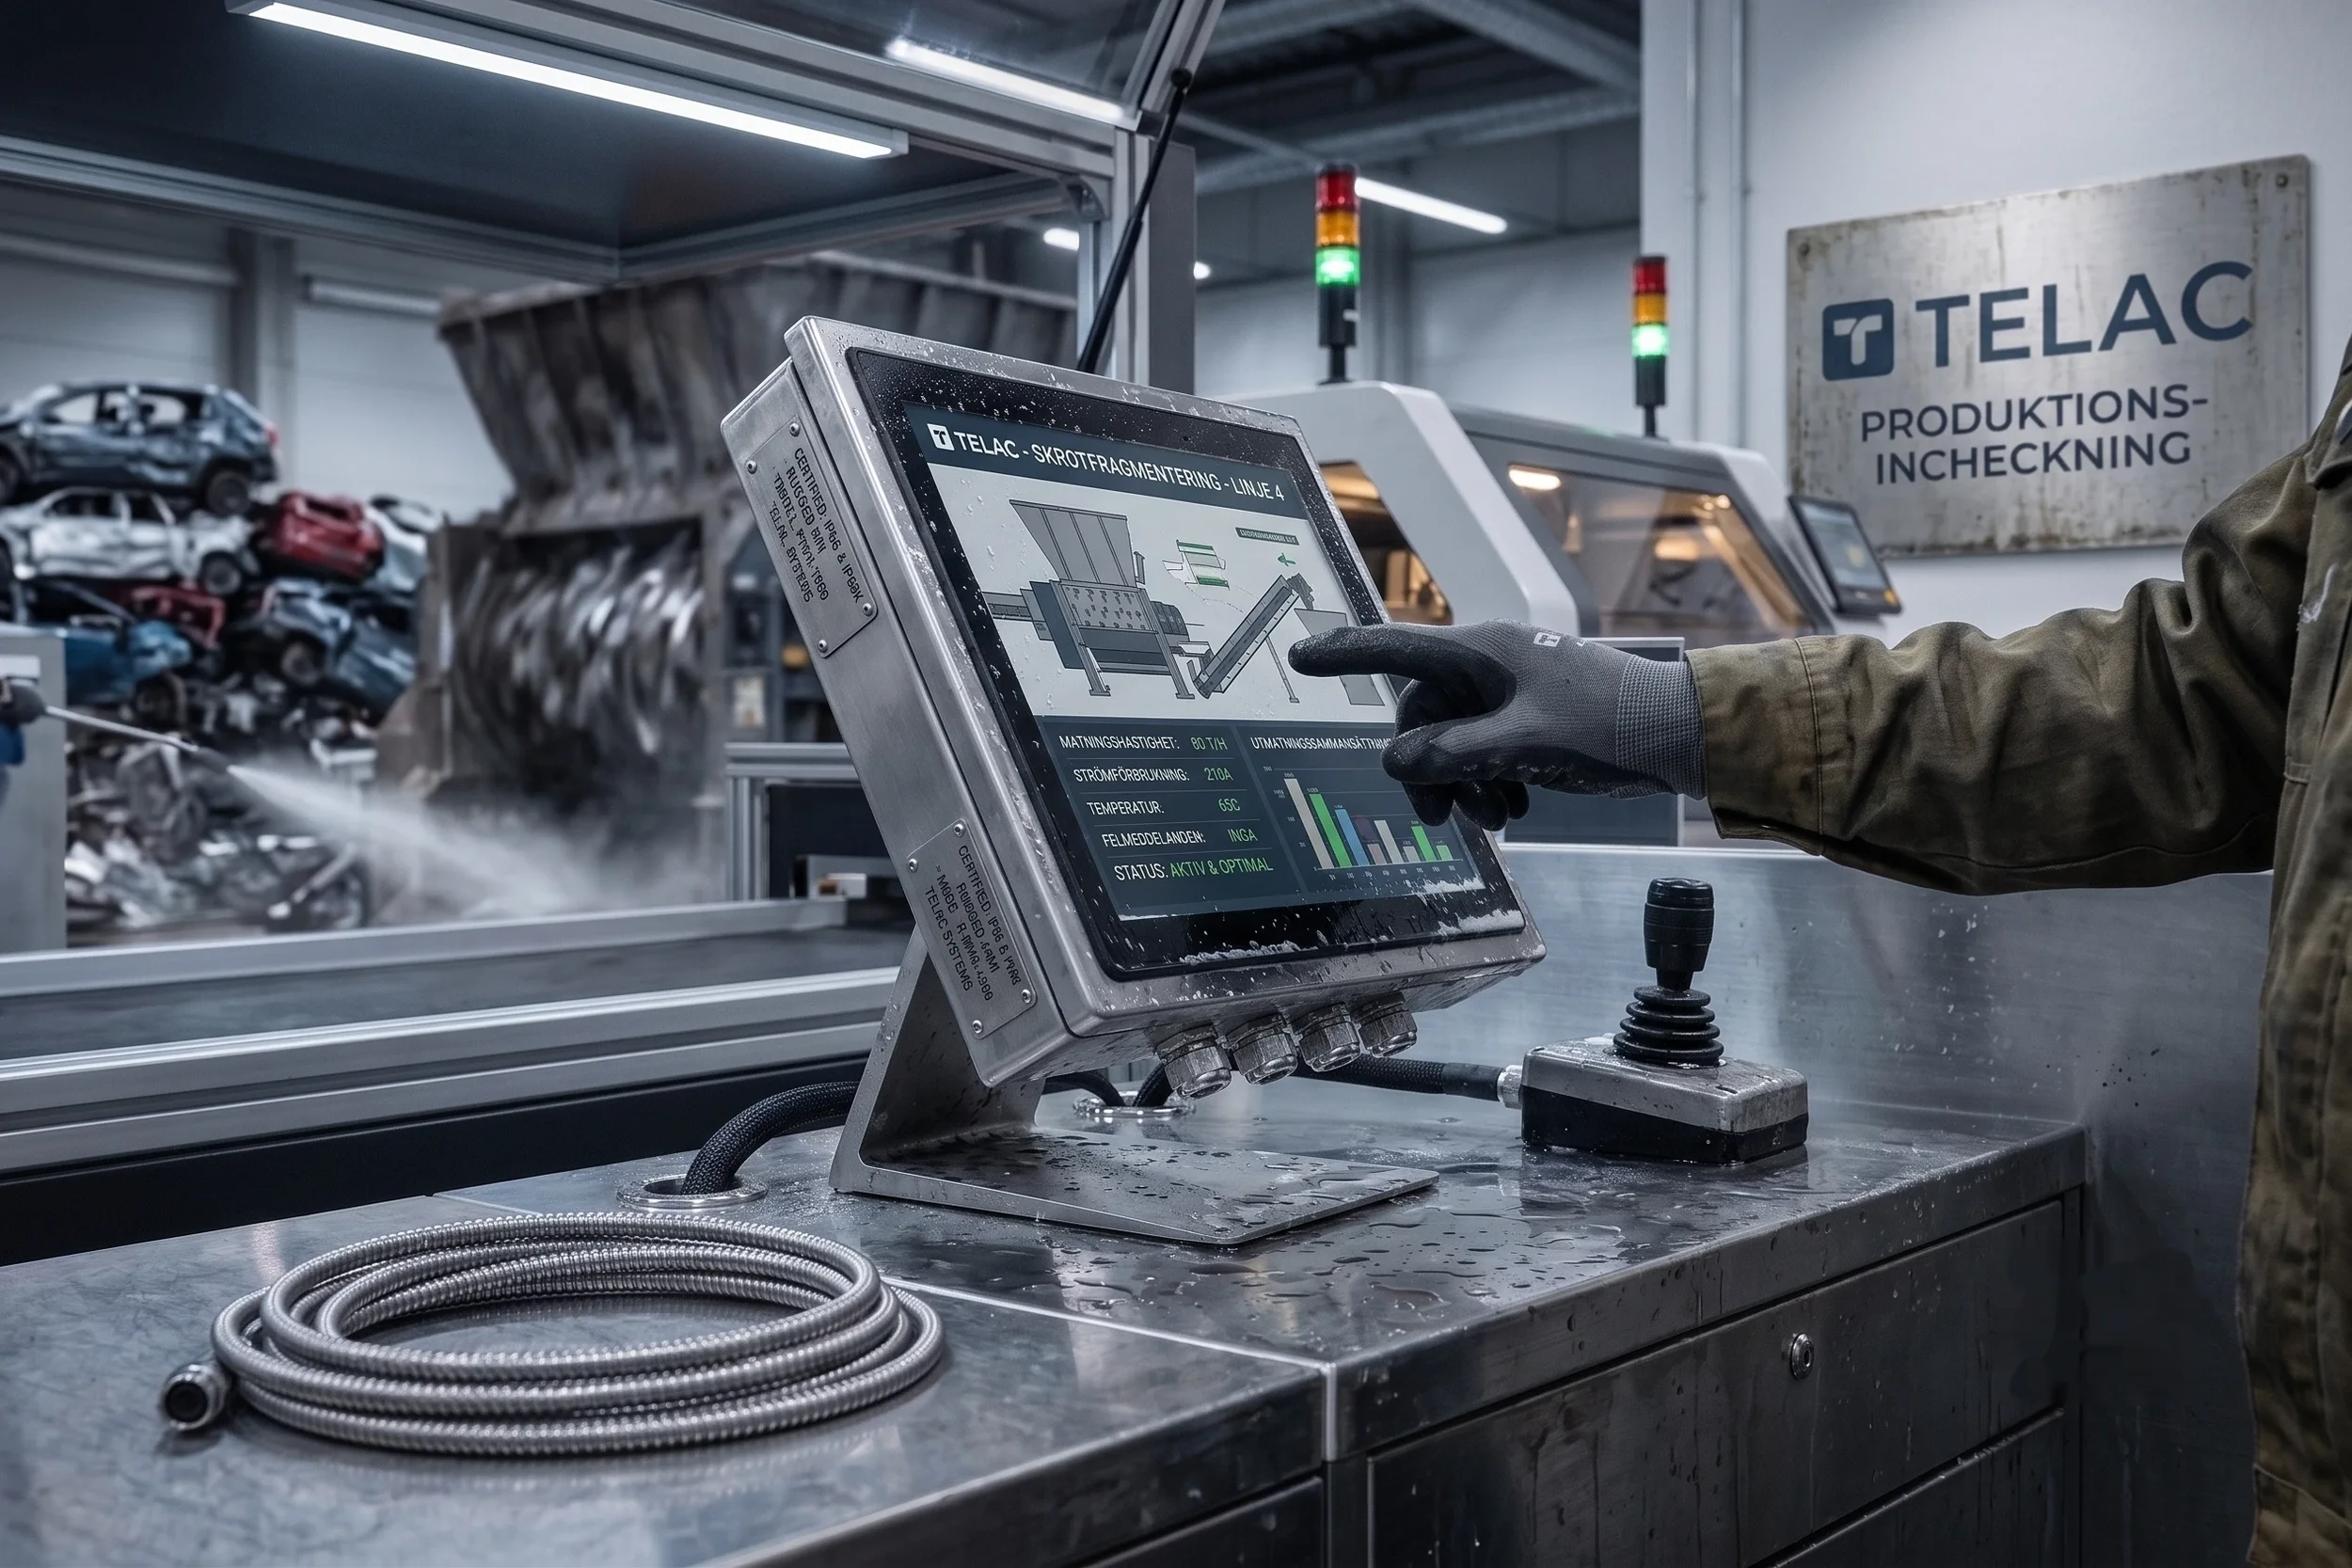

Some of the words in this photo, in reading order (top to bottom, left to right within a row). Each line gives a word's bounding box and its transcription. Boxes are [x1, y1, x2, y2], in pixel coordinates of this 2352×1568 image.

[1915, 261, 2253, 368] TELAC
[1861, 384, 2209, 442] PRODUKTIONS-
[953, 431, 1020, 459] TELAC
[1031, 444, 1222, 491] SKROTFRAGMENTERING
[1230, 477, 1274, 500] LINJE
[1275, 484, 1285, 501] 4
[1876, 431, 2191, 484] INCHECKNING
[1058, 736, 1180, 750] MATNINGSHASTIGHET:
[1190, 736, 1206, 751] 80
[1073, 767, 1190, 782] STRÖMFÖRBRUKNING:
[1204, 768, 1233, 782] 210A
[1087, 800, 1165, 816] TEMPERATUR:
[1102, 831, 1206, 847] FELMEDDELANDEN:
[1227, 829, 1258, 843] INGA
[1114, 863, 1168, 880] STATUS:
[1169, 860, 1205, 878] AKTIV
[1208, 860, 1219, 875] &
[1219, 857, 1274, 873] OPTIMAL
